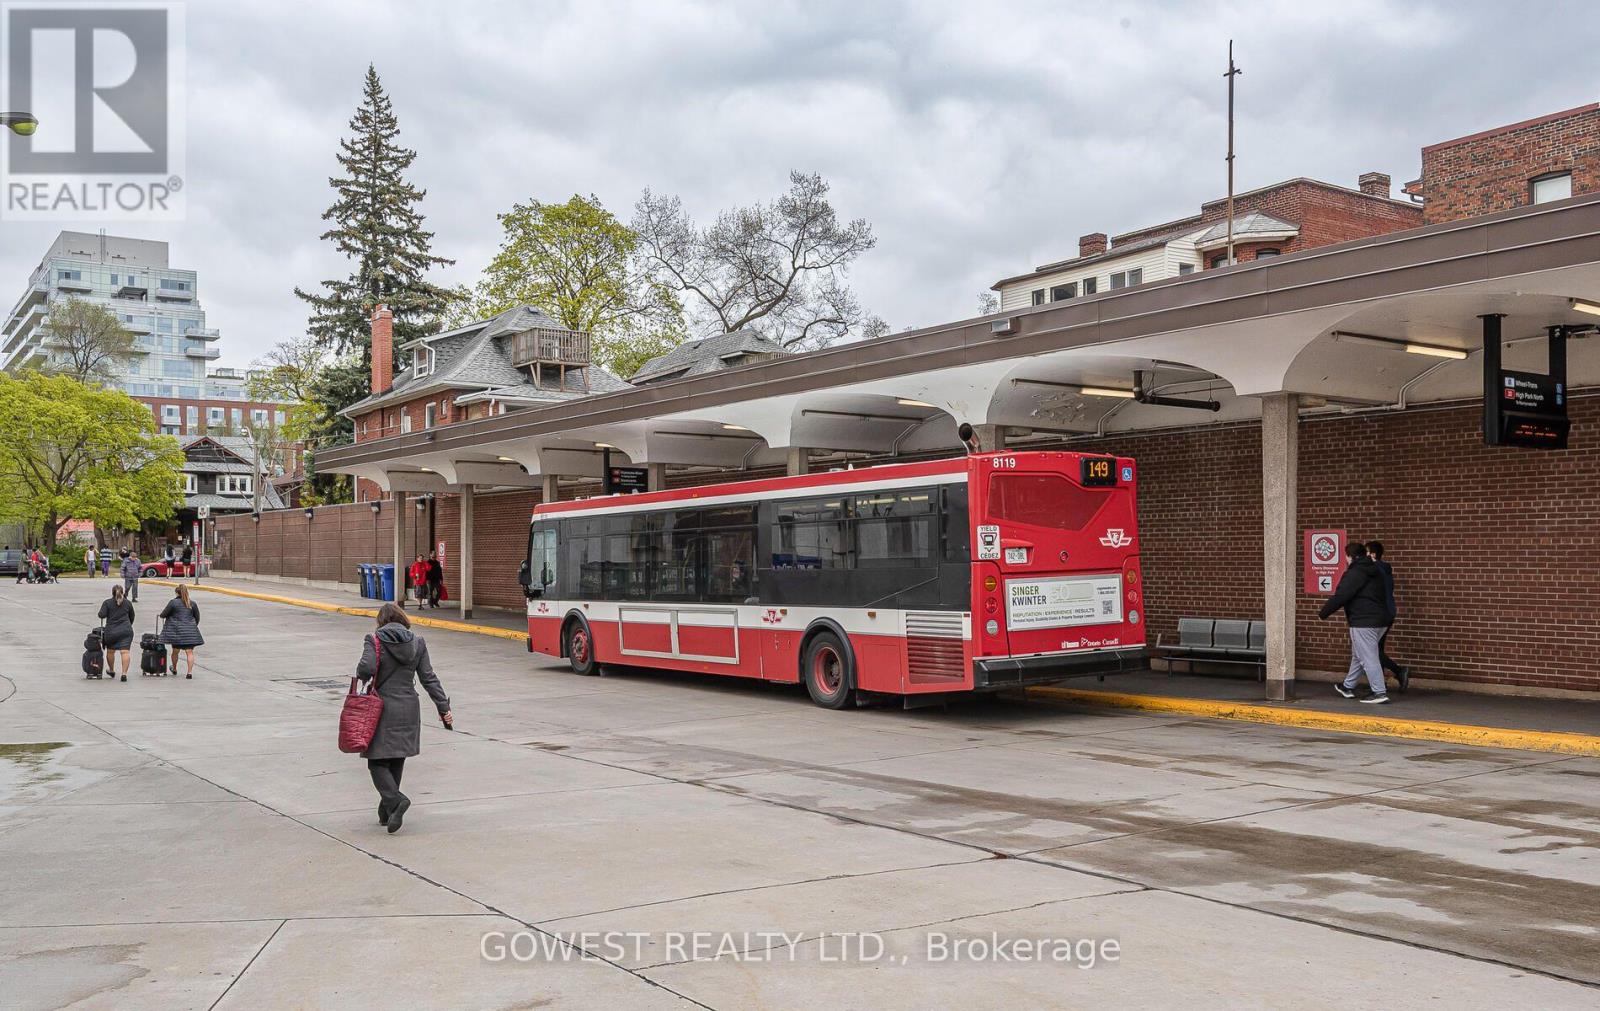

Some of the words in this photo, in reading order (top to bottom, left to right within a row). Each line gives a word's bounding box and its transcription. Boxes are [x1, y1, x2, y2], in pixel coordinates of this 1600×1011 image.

[992, 457, 1016, 468] 8119
[1089, 461, 1108, 477] 149
[1012, 586, 1040, 596] SINGER
[1012, 596, 1047, 606] KWINTER
